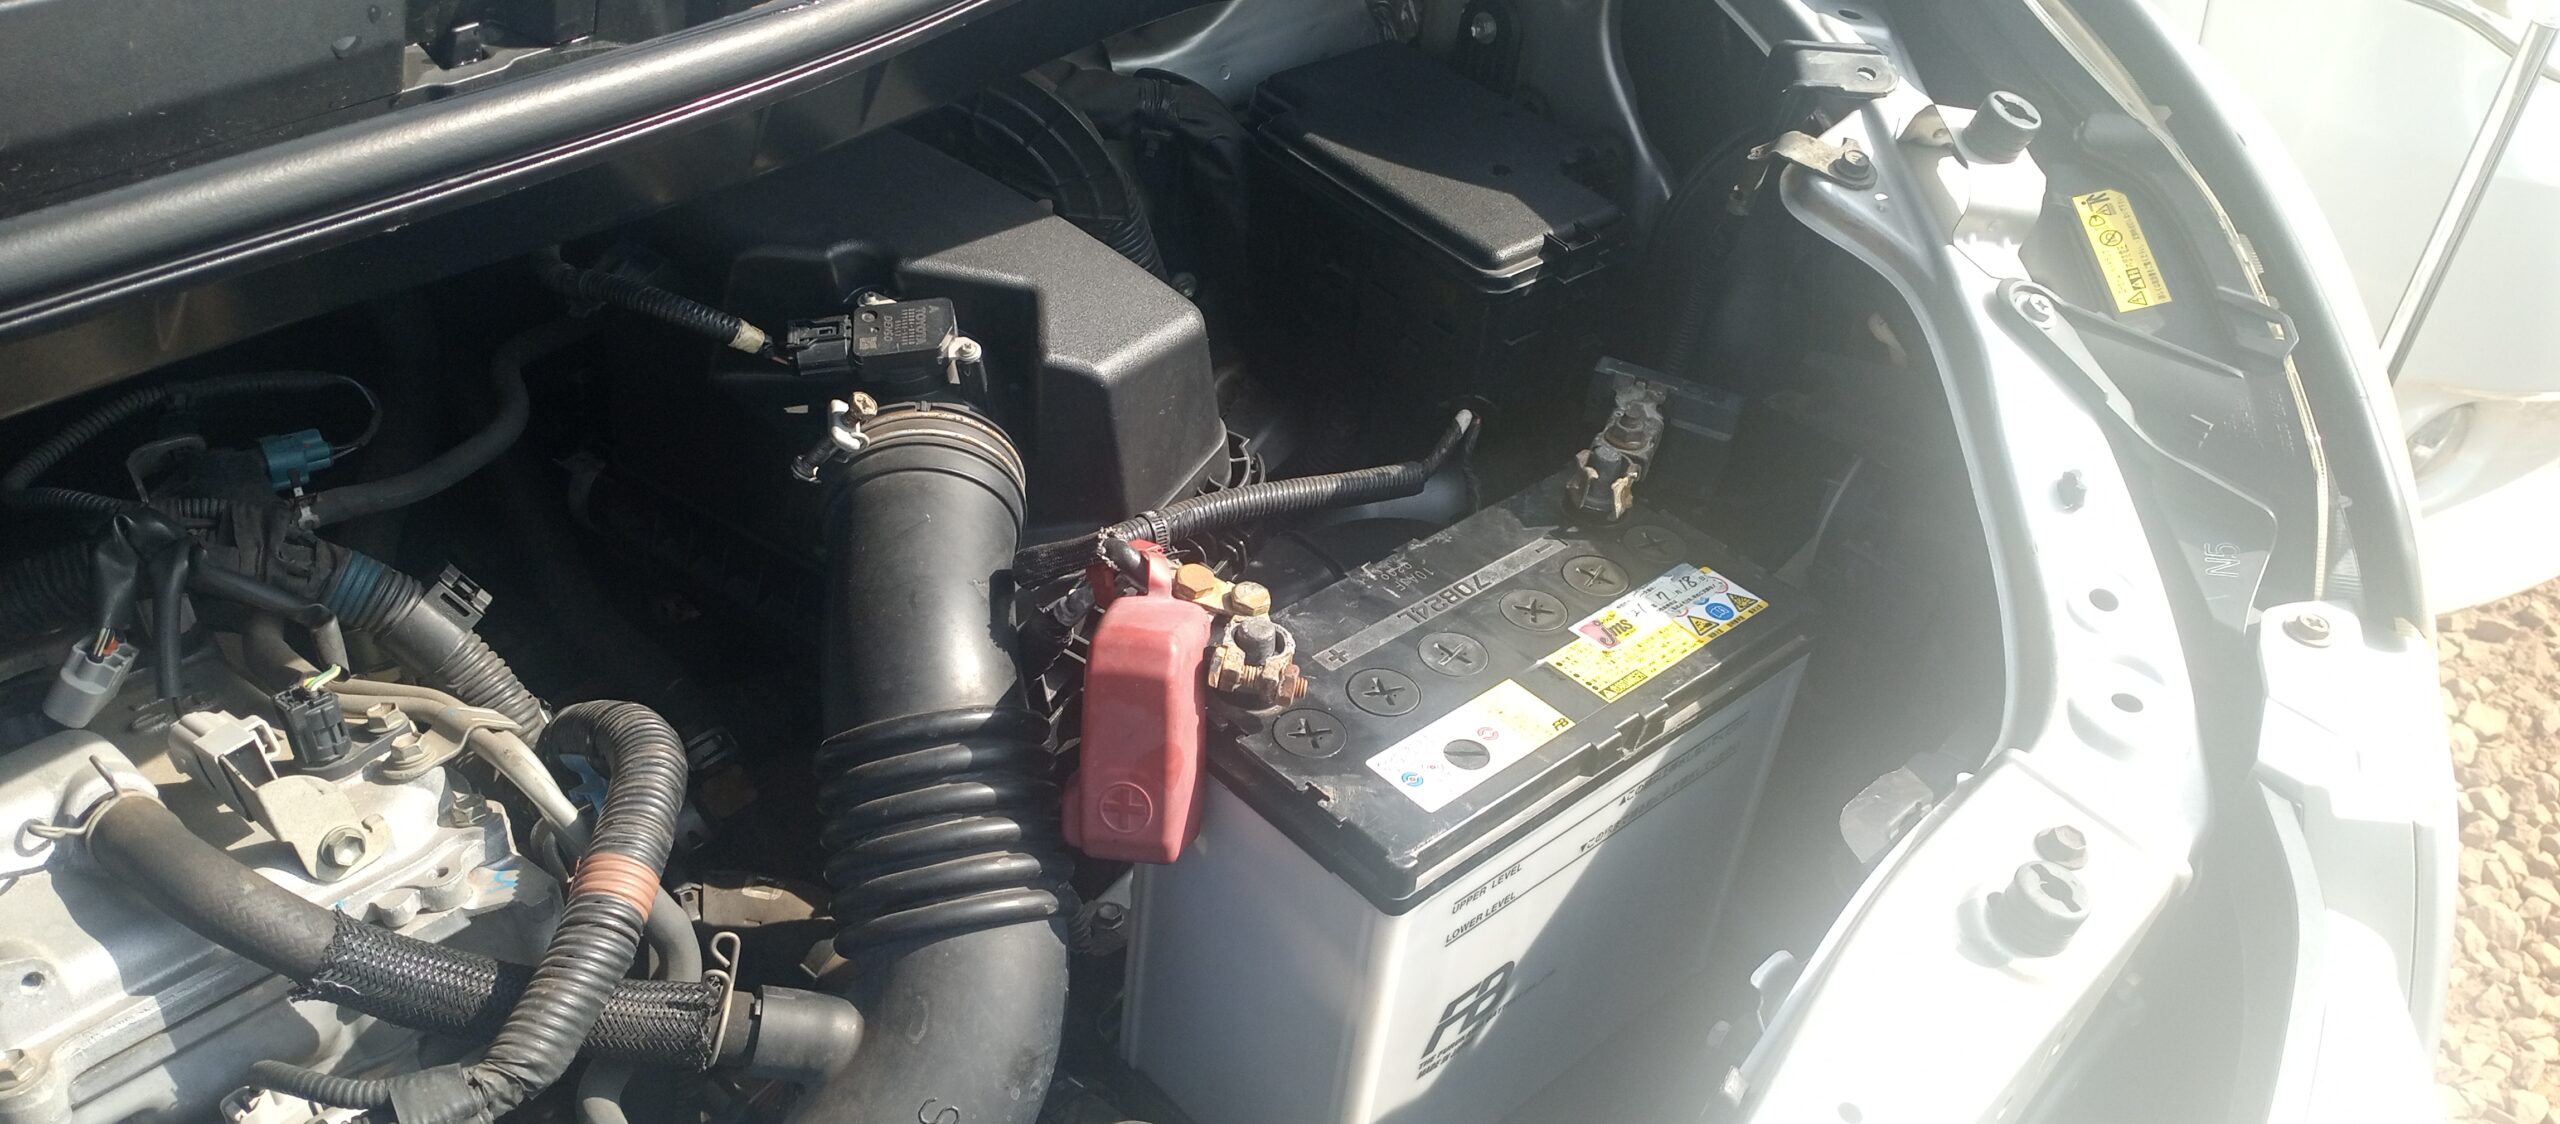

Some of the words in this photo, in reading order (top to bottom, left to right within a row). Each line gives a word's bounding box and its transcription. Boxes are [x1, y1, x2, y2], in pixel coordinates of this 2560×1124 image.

[883, 315, 894, 342] DENSO
[915, 306, 927, 346] TOYOTA
[2203, 542, 2241, 578] N5
[1397, 576, 1495, 626] 70B24L
[1451, 885, 1488, 915] UPPER
[1490, 863, 1523, 888] LEVEL
[1445, 914, 1484, 944] LOWER
[1485, 892, 1517, 918] LEVEL
